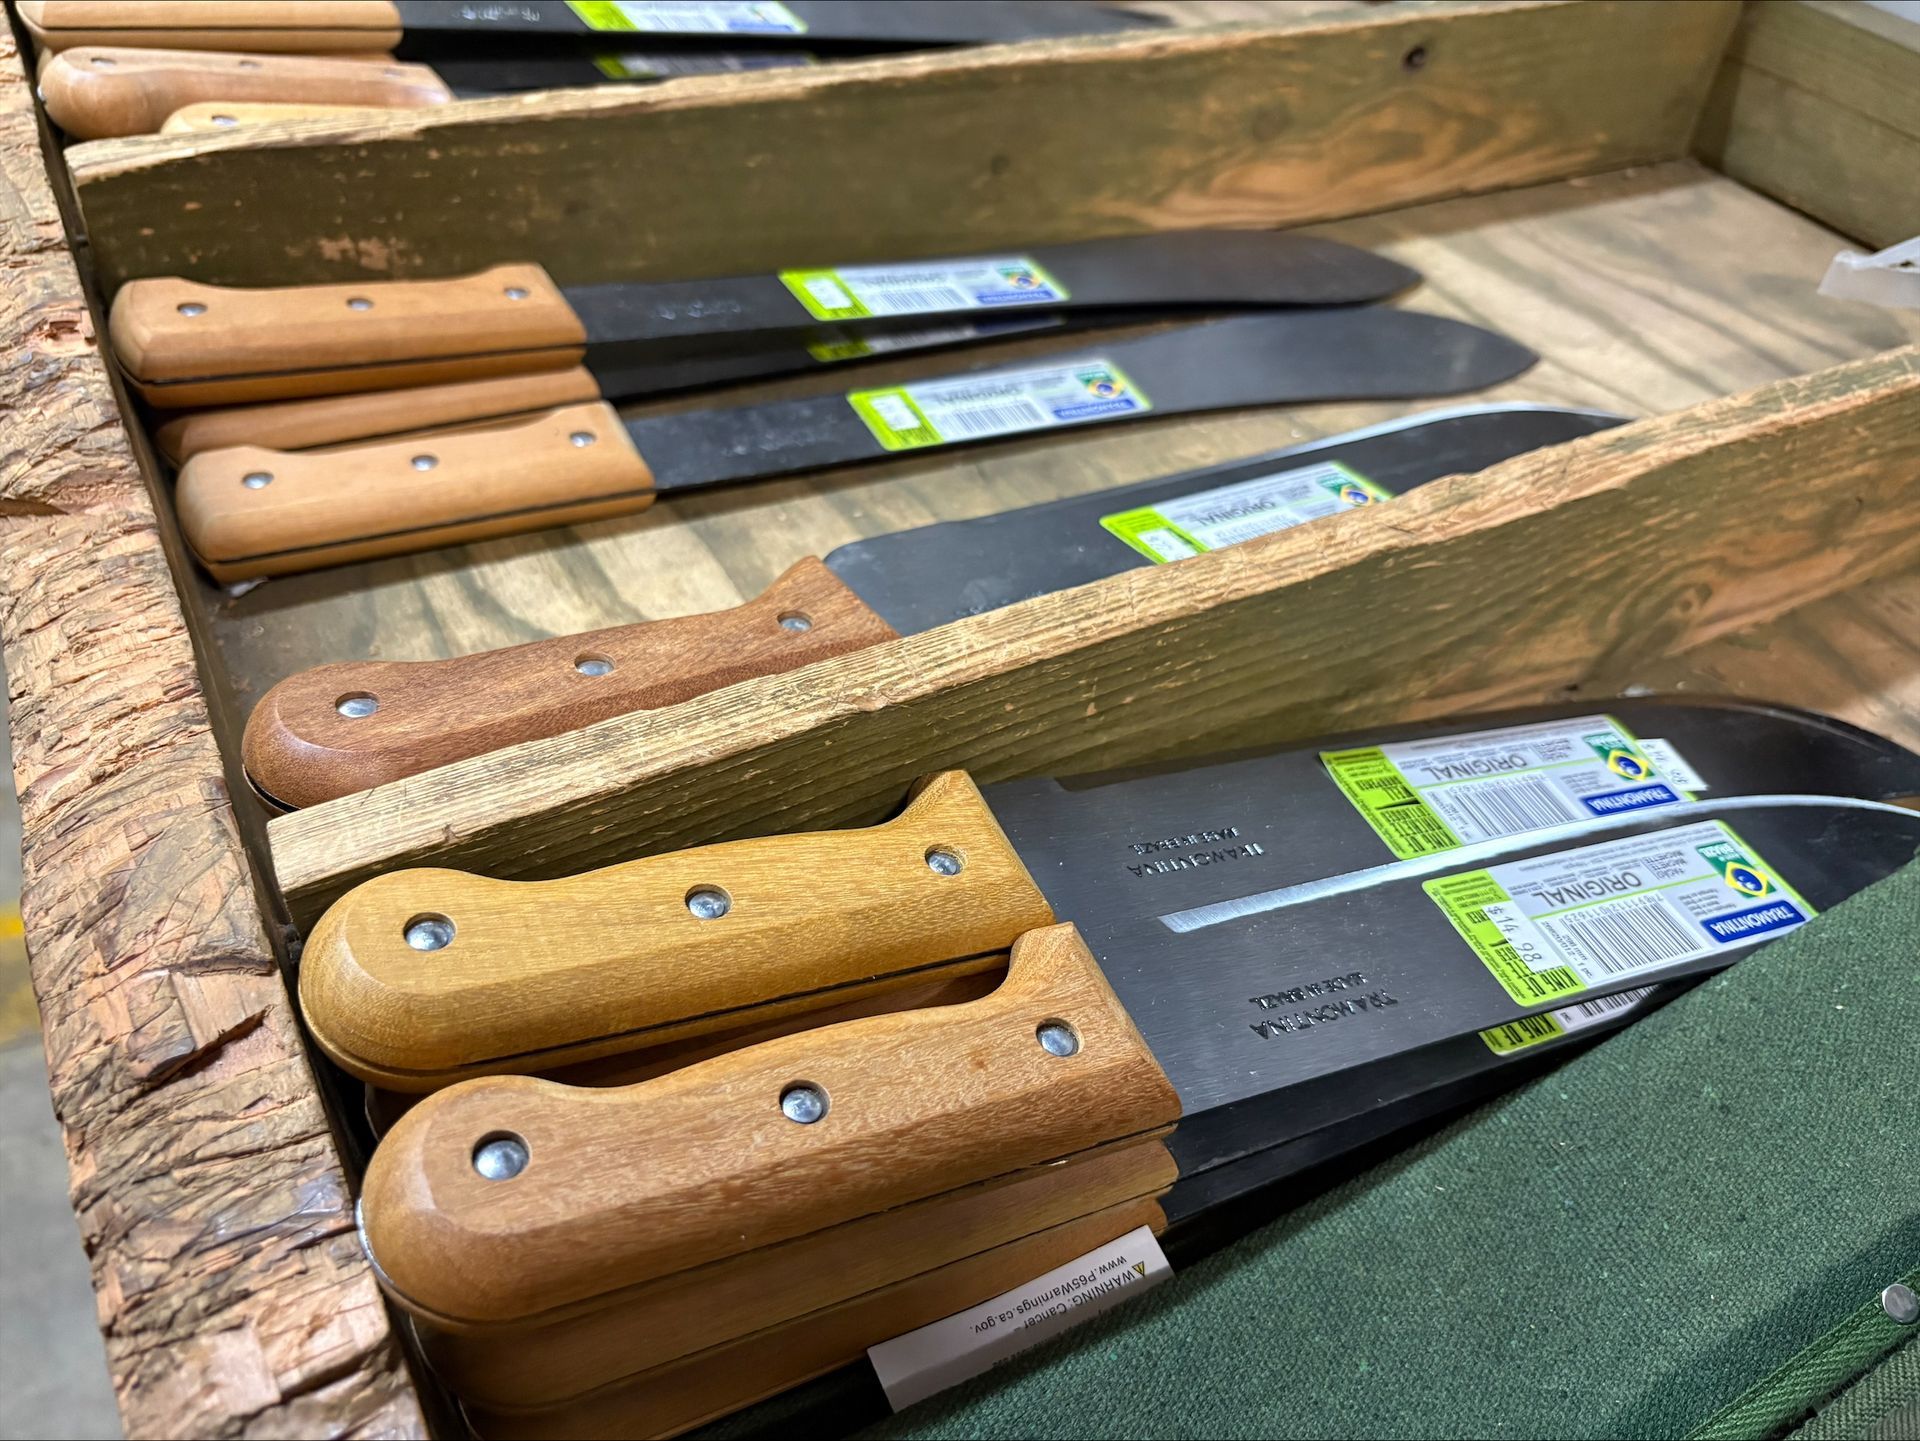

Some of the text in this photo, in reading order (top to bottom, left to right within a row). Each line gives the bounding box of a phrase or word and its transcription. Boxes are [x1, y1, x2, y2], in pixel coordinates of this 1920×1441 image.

[1418, 753, 1529, 782] ORIGINAL
[1585, 786, 1671, 811] TRAMONTINA
[1419, 831, 1455, 848] KING
[1530, 870, 1643, 909] ORIGINAL
[1485, 905, 1541, 962] $14.98
[1709, 904, 1794, 937] TRAMONTINA
[1520, 976, 1545, 997] OF
[1538, 968, 1576, 991] KING
[1248, 988, 1397, 1039] TRAMONTINA
[1517, 1014, 1555, 1038] KING
[1499, 1024, 1522, 1044] OF
[1066, 1269, 1135, 1307] WARNING:
[1022, 1301, 1067, 1329] Cancer
